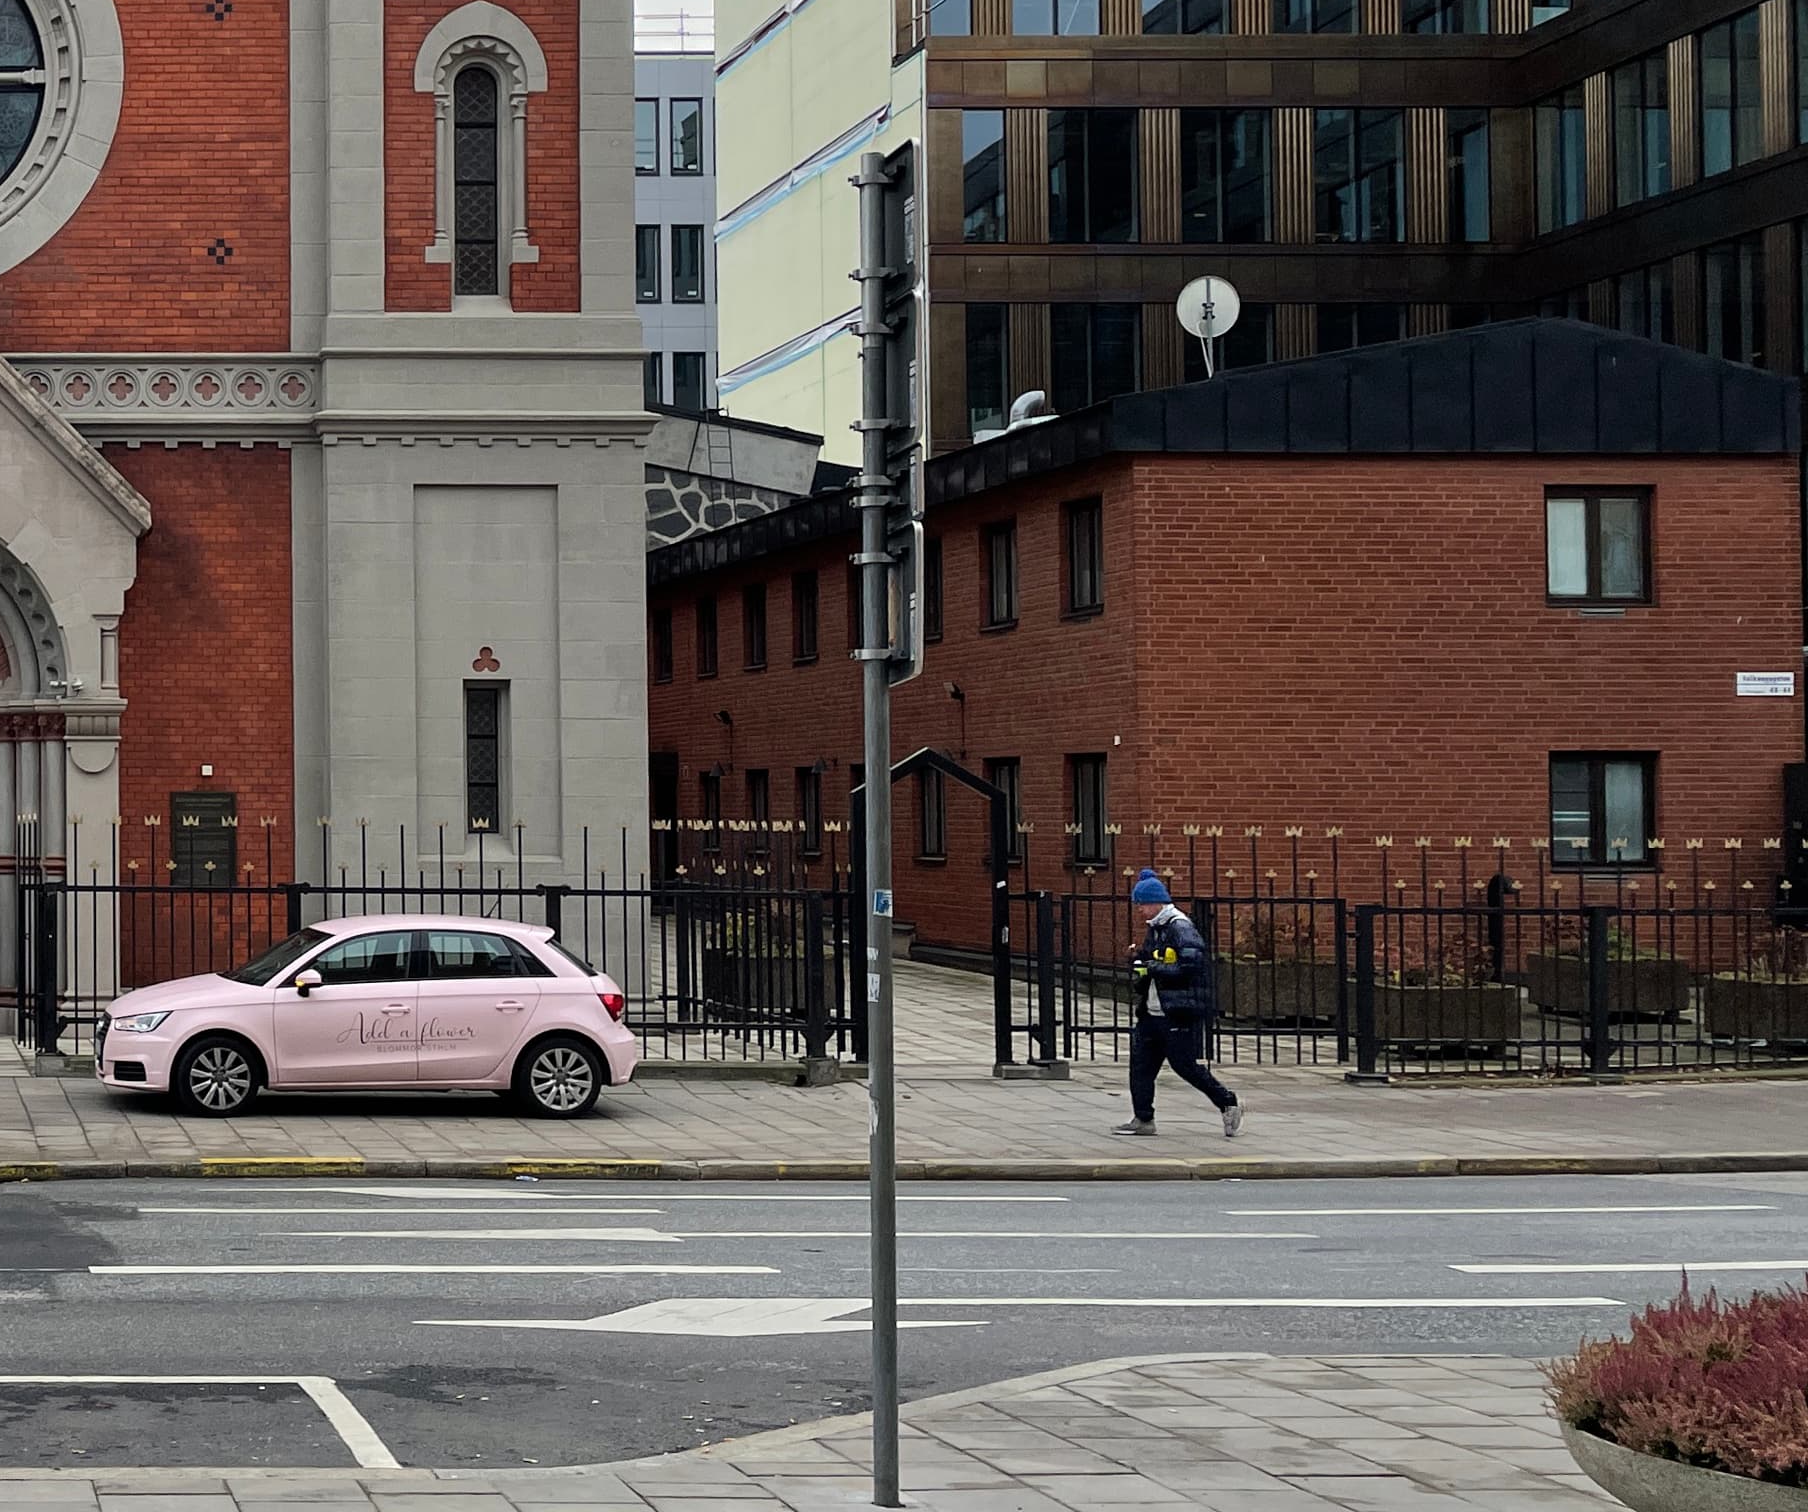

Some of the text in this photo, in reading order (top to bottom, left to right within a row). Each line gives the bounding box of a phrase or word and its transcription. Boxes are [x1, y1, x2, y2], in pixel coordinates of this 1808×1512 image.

[336, 1011, 476, 1046] Add a flower
